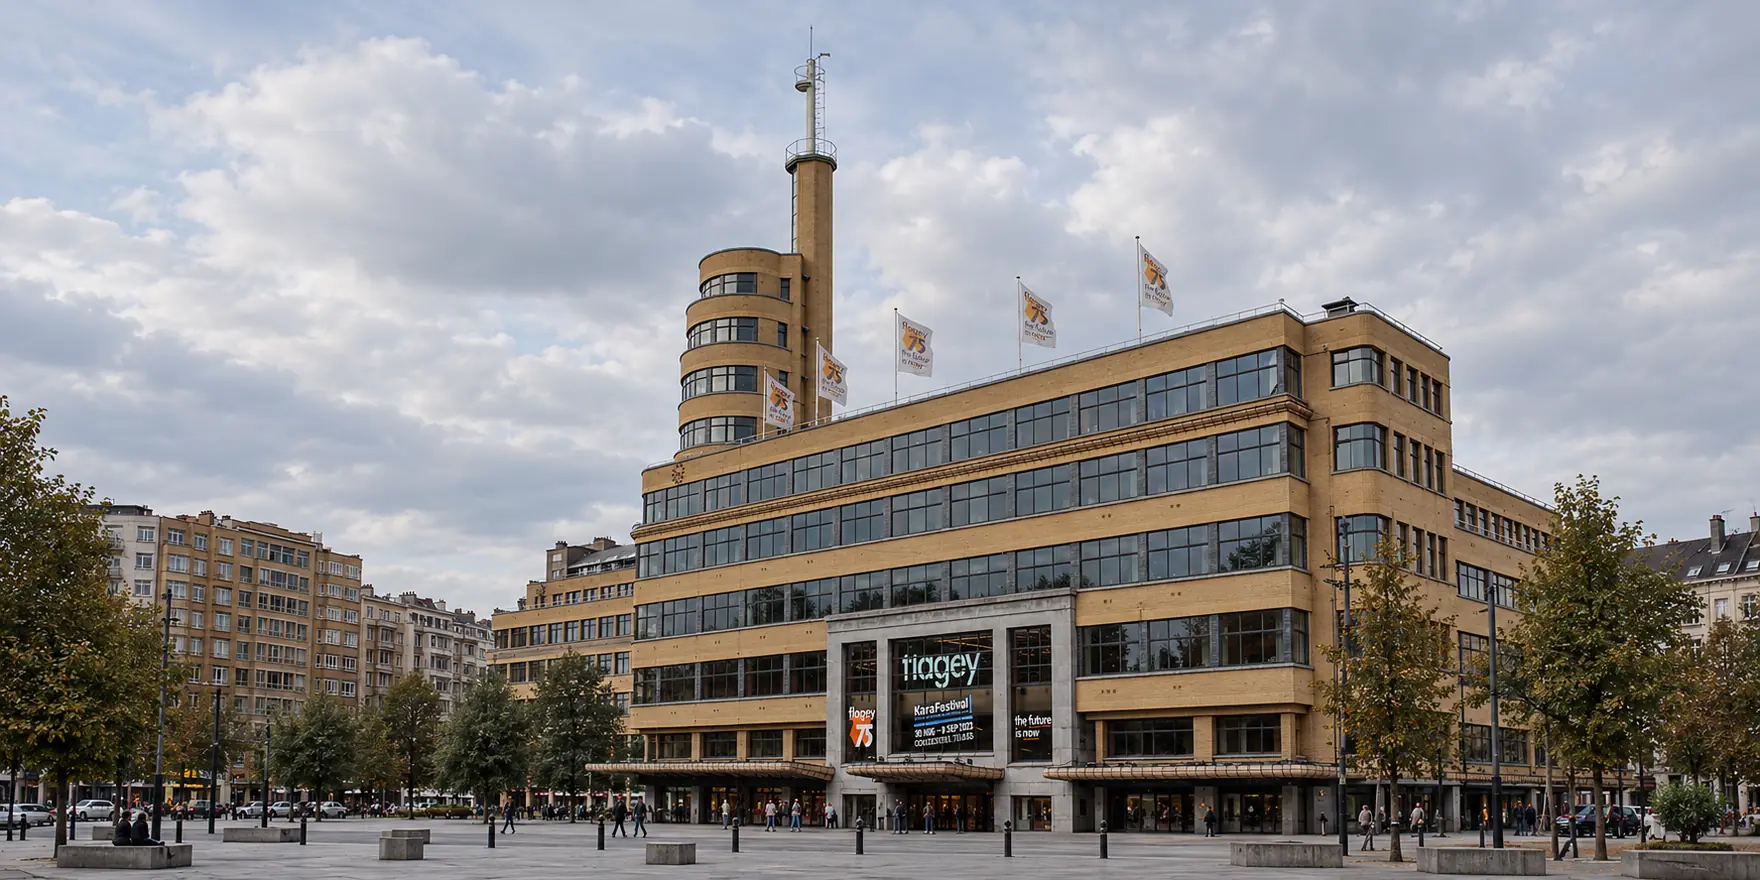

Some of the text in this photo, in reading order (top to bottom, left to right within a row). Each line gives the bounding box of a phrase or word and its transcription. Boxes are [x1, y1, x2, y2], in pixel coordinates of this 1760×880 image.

[1031, 306, 1048, 325] 75
[908, 335, 926, 354] 75
[1015, 714, 1052, 726] the future
[855, 723, 873, 747] 75
[1015, 727, 1022, 738] is
